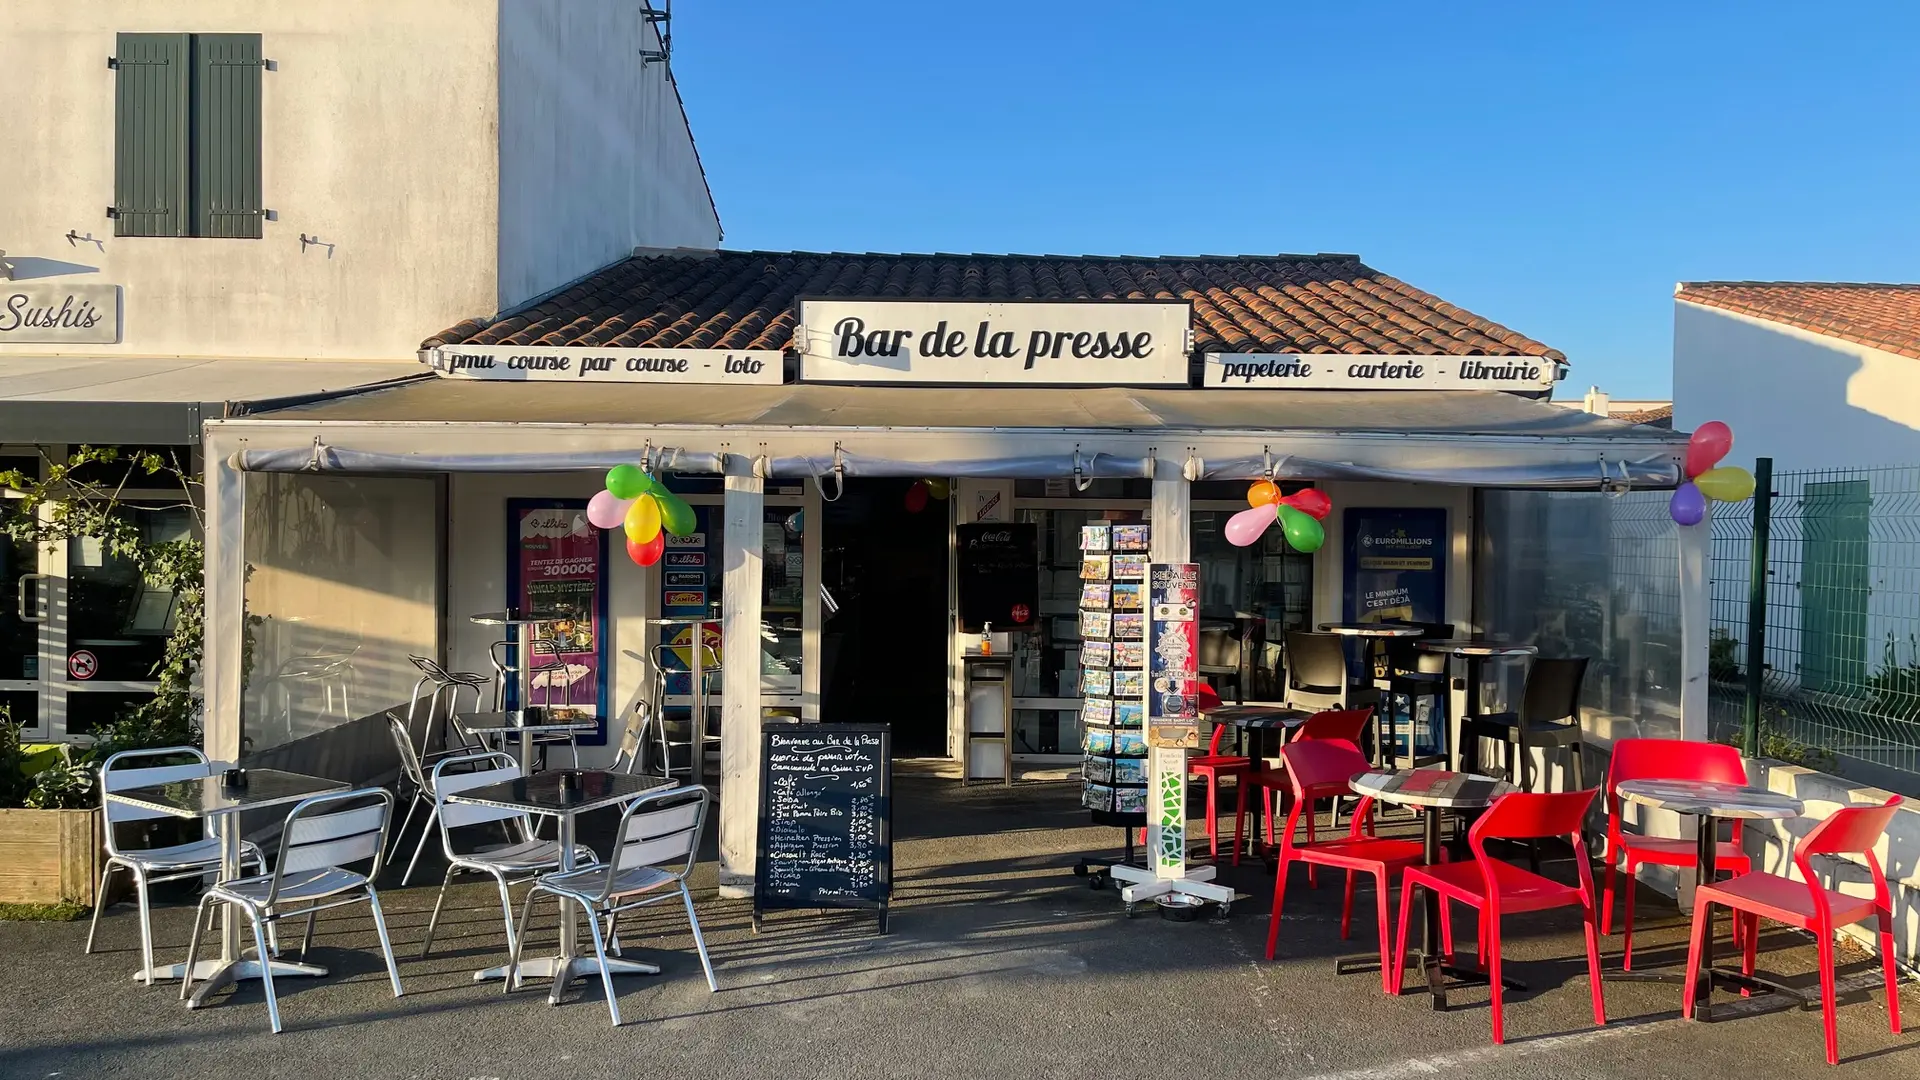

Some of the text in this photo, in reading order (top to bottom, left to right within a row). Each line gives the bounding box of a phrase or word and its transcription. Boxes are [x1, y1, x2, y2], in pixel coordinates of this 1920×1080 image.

[0, 294, 102, 331] Sushis
[834, 317, 1154, 370] Bar de la presse
[449, 353, 497, 374] pmu
[507, 354, 570, 371] course
[579, 355, 617, 377] par
[625, 356, 689, 373] course
[724, 354, 764, 374] loto
[1221, 359, 1311, 383] papeterie
[1347, 360, 1424, 380] carterie
[1459, 359, 1540, 381] librairie
[540, 517, 568, 529] illiko
[1374, 538, 1433, 546] EUROMILLIONS
[564, 557, 593, 565] GAGNER
[678, 554, 701, 564] illiko
[1152, 581, 1197, 590] SOUVENIR
[1375, 588, 1409, 598] MINIMUM
[1366, 595, 1411, 608] C'EST DÉJÀ
[843, 736, 853, 746] de
[803, 754, 815, 762] de
[845, 750, 871, 761] votre
[830, 808, 843, 817] Bio
[775, 834, 811, 842] Heineken
[812, 833, 842, 843] Pression
